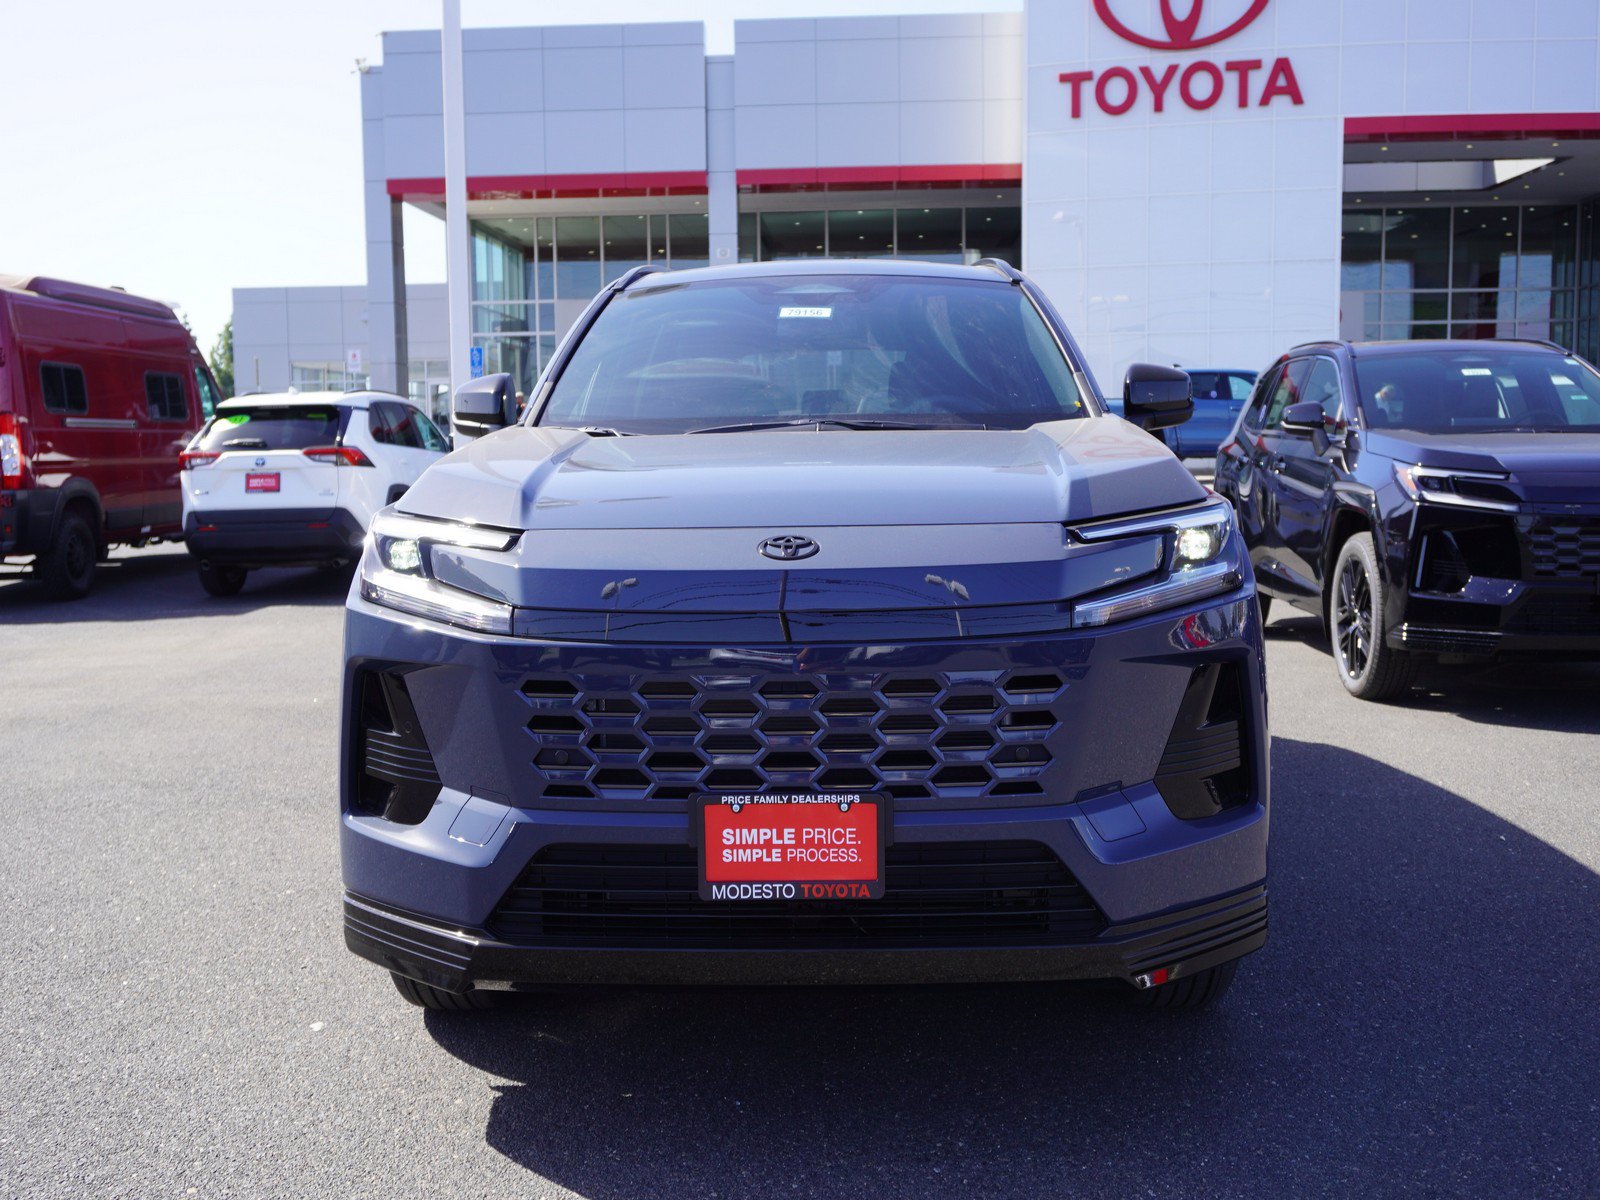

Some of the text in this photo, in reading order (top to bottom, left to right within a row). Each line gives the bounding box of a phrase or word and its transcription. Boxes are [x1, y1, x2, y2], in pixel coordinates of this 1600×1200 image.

[1058, 57, 1304, 119] TOYOTA
[786, 308, 823, 316] 79156
[721, 794, 861, 804] PRICE FAMILY DEALERSHIPS
[722, 827, 862, 845] SIMPLE PRICE.
[722, 848, 862, 863] SIMPLE PROCESS.
[712, 883, 871, 899] MODESTO TOYOTA
